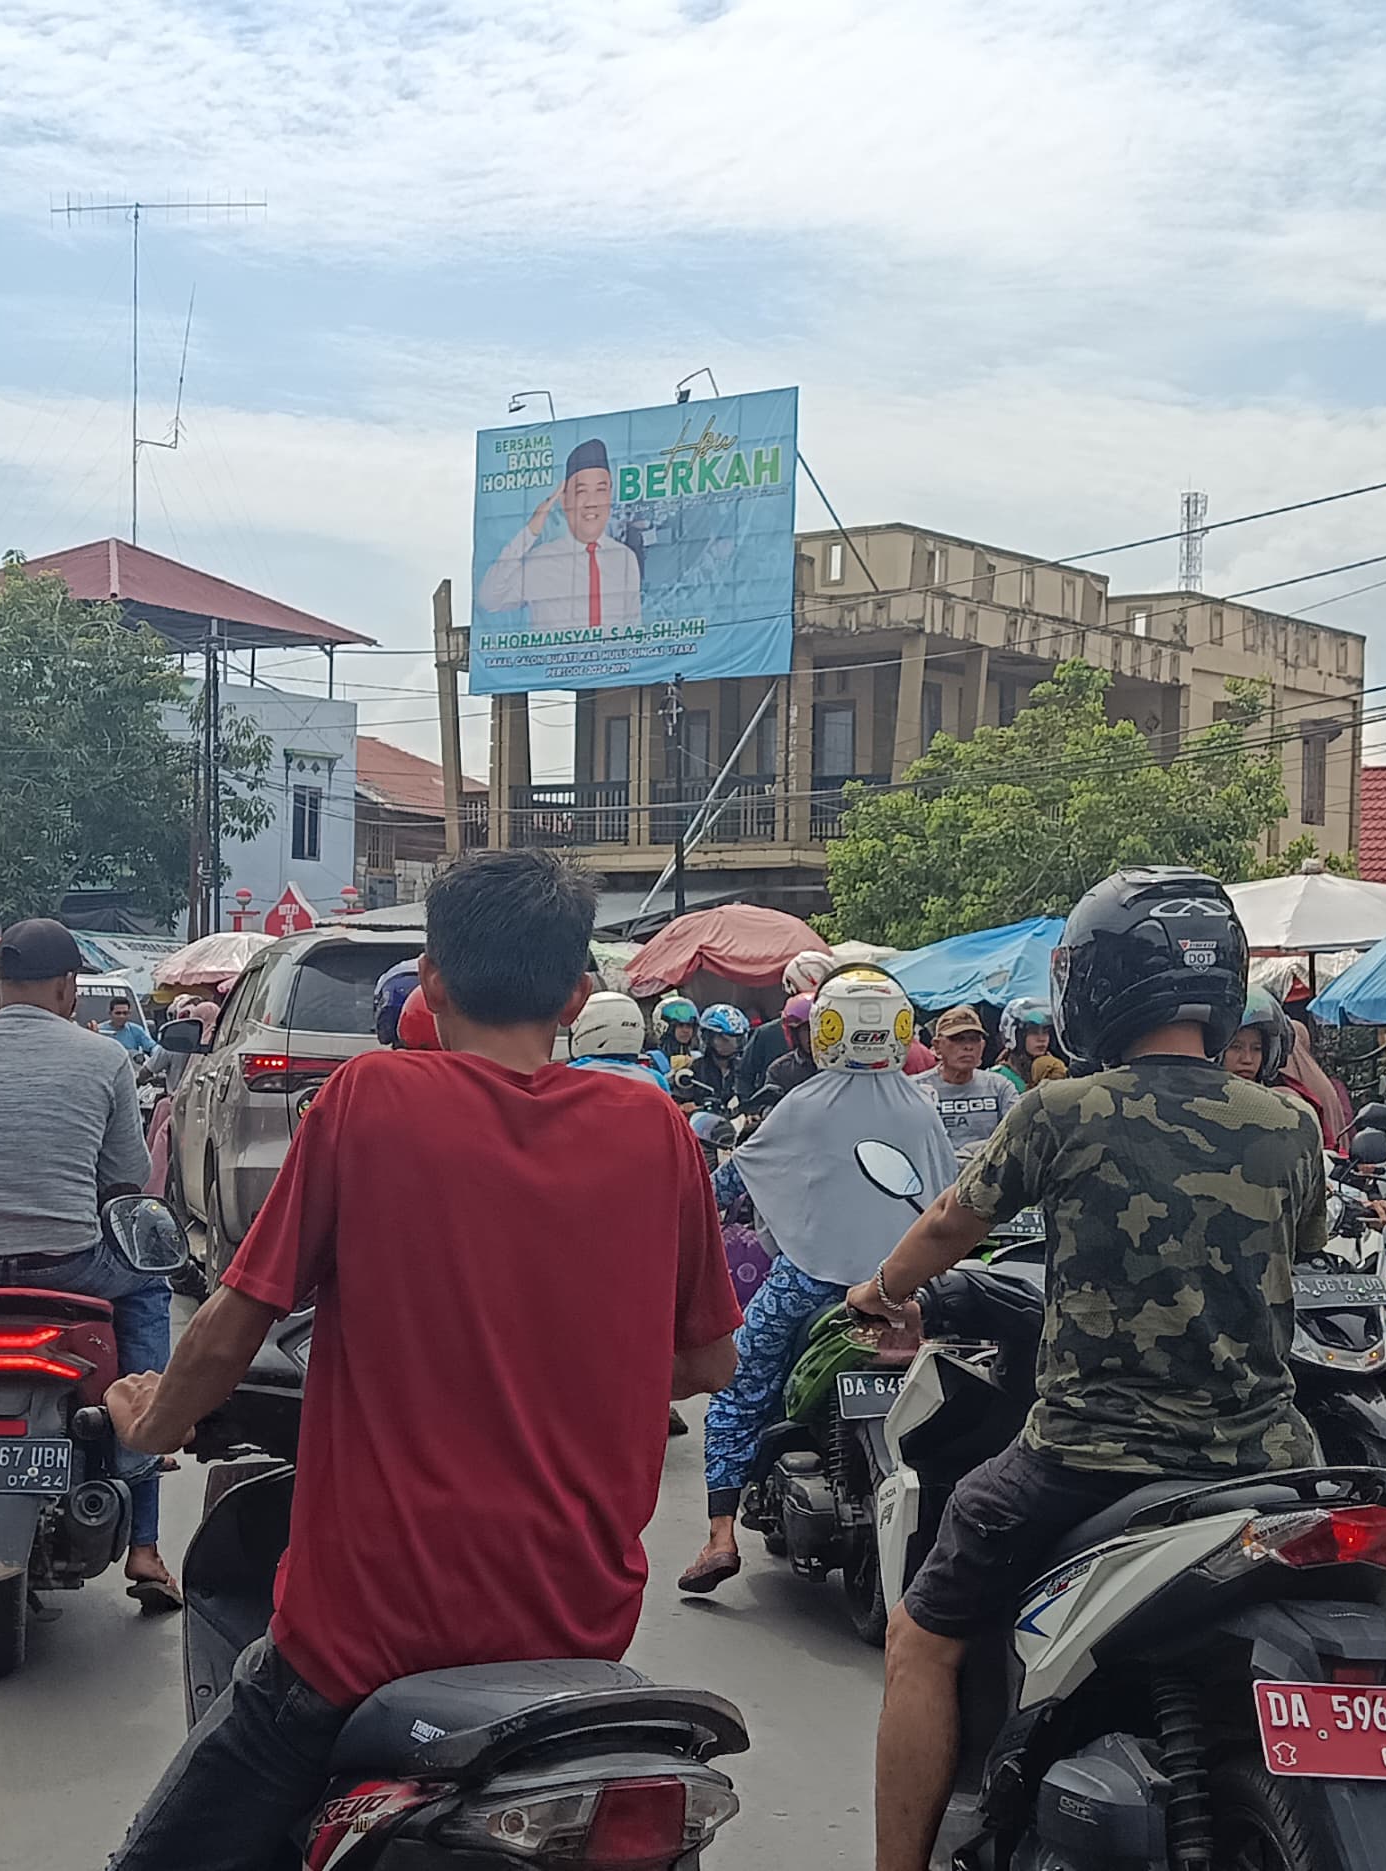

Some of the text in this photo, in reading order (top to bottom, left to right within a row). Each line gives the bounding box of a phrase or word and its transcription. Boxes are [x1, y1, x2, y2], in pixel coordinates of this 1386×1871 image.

[495, 435, 552, 453] BERSAMA
[508, 449, 553, 471] BANG
[482, 468, 553, 493] HORMAN
[618, 446, 782, 503] BERKAH
[1188, 953, 1212, 964] DOT
[852, 1030, 889, 1044] GM
[842, 1377, 867, 1396] DA
[1266, 1690, 1312, 1729] DA
[323, 1793, 390, 1825] REVO
